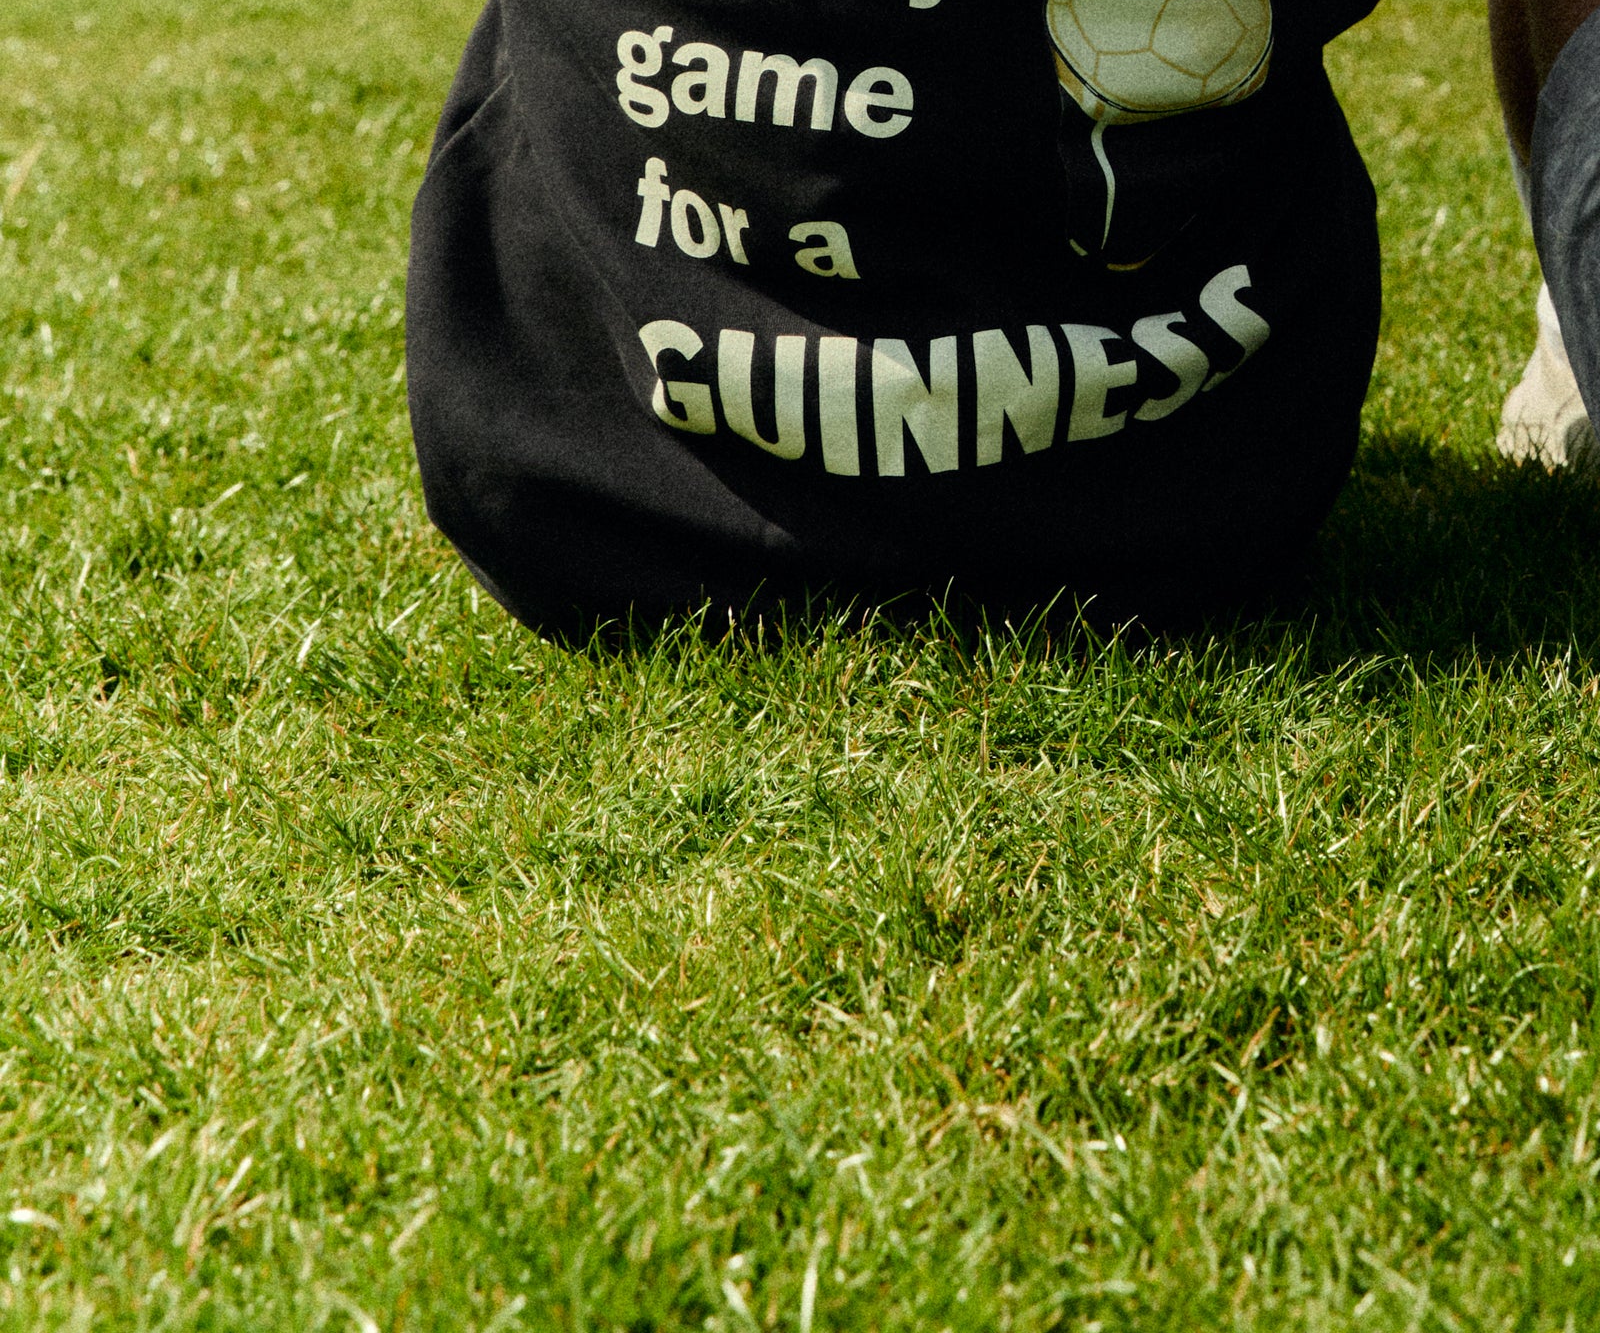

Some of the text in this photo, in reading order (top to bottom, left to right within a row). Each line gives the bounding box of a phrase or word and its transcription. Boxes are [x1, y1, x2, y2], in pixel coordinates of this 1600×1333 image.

[616, 26, 915, 139] game
[634, 157, 861, 279] for a
[638, 264, 1271, 477] GUINNESS
